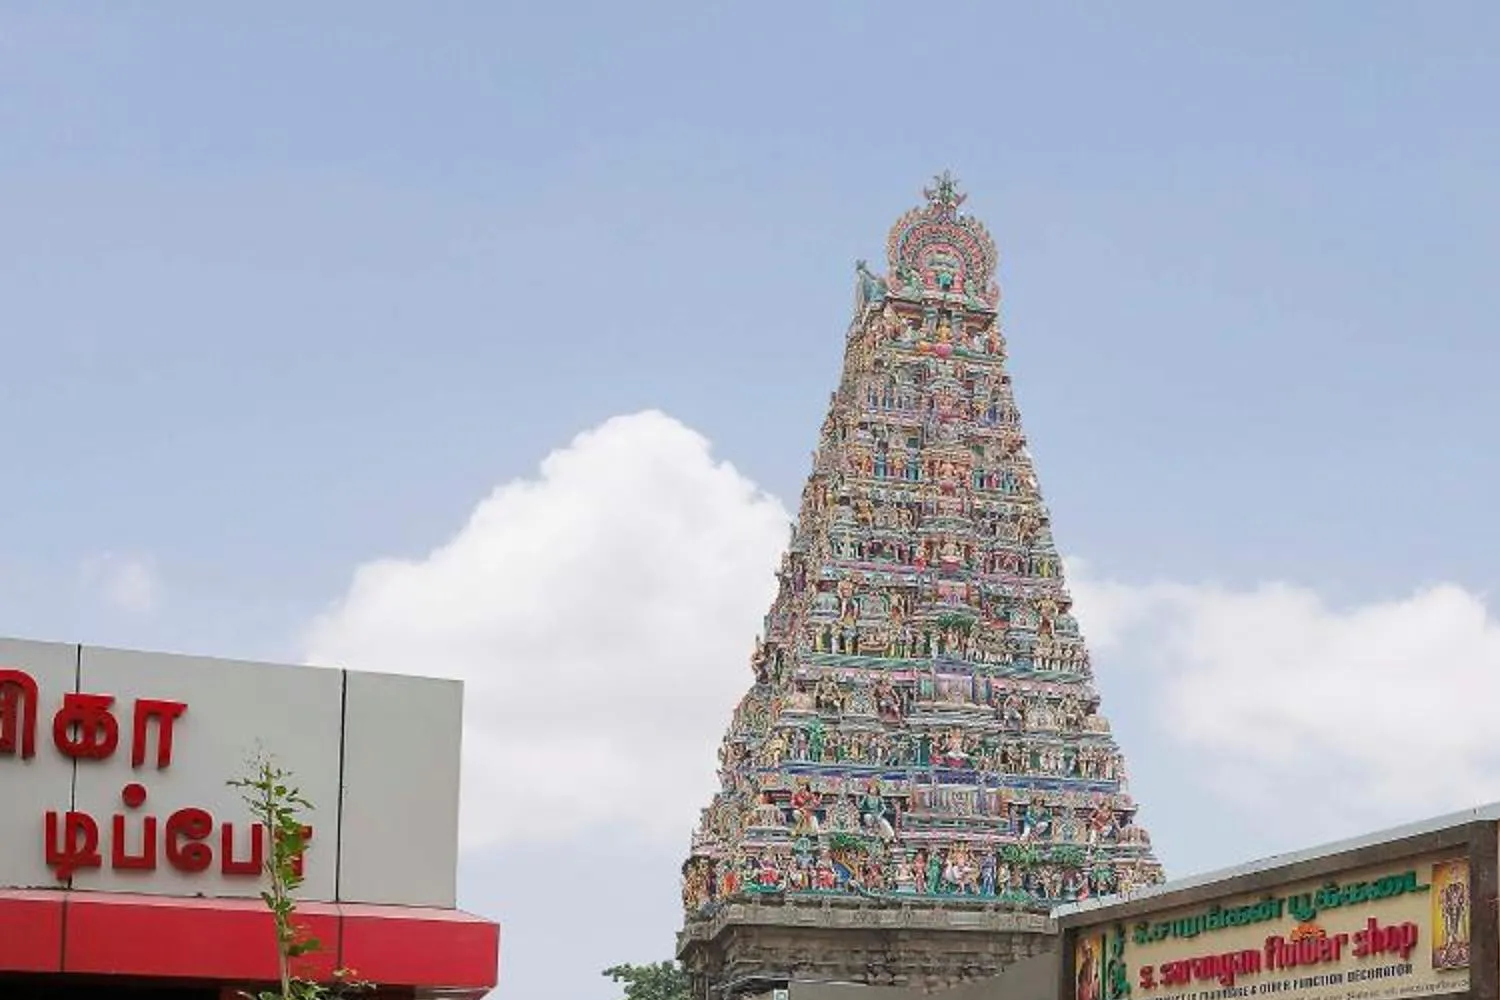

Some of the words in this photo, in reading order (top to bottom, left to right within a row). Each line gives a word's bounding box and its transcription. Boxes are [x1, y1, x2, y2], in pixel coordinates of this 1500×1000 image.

[1264, 934, 1349, 973] flower
[1352, 917, 1418, 961] shop
[1294, 972, 1344, 990] FUNCTION
[1347, 963, 1413, 984] DECORATOR
